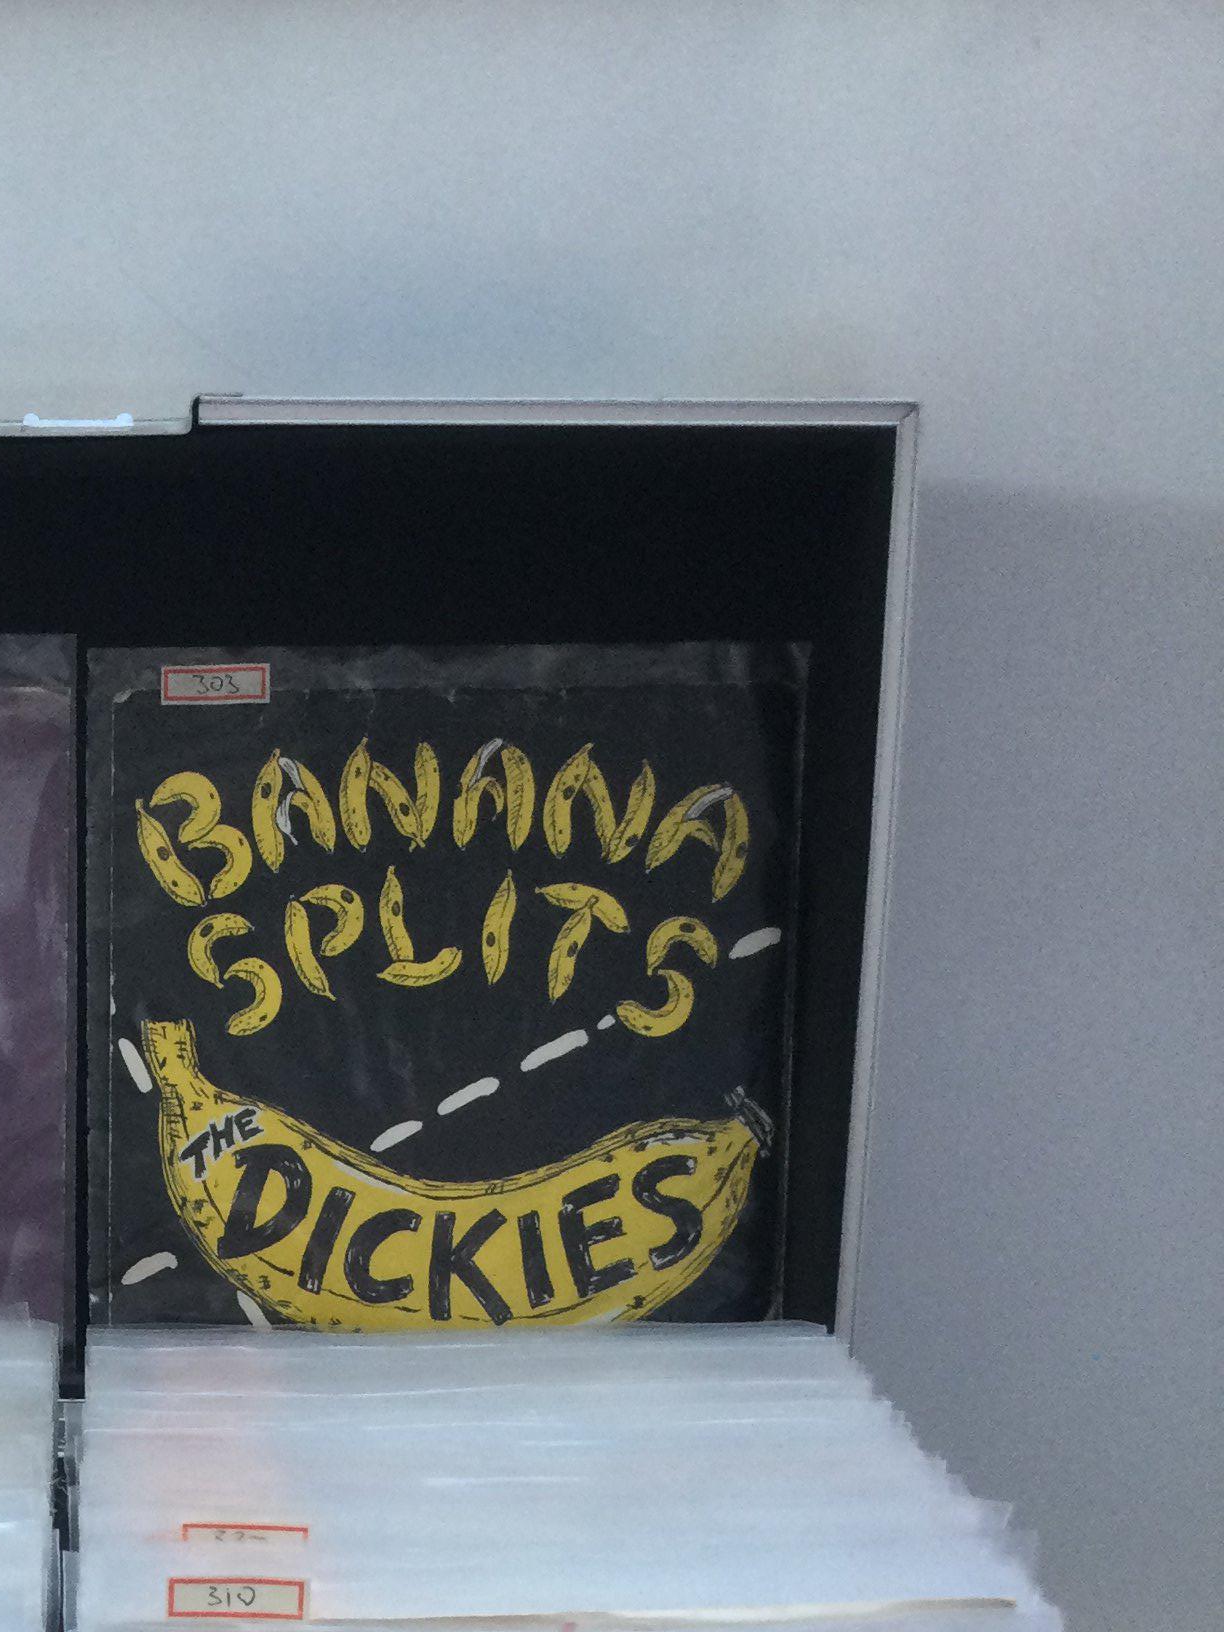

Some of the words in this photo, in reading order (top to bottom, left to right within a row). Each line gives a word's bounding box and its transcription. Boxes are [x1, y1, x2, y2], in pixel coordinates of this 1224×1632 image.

[192, 674, 239, 694] 303
[135, 736, 750, 907] BANANA
[187, 866, 719, 1037] SPLITS
[180, 1107, 264, 1180] THE
[218, 1141, 704, 1326] DICKIES
[207, 1586, 256, 1607] 310
